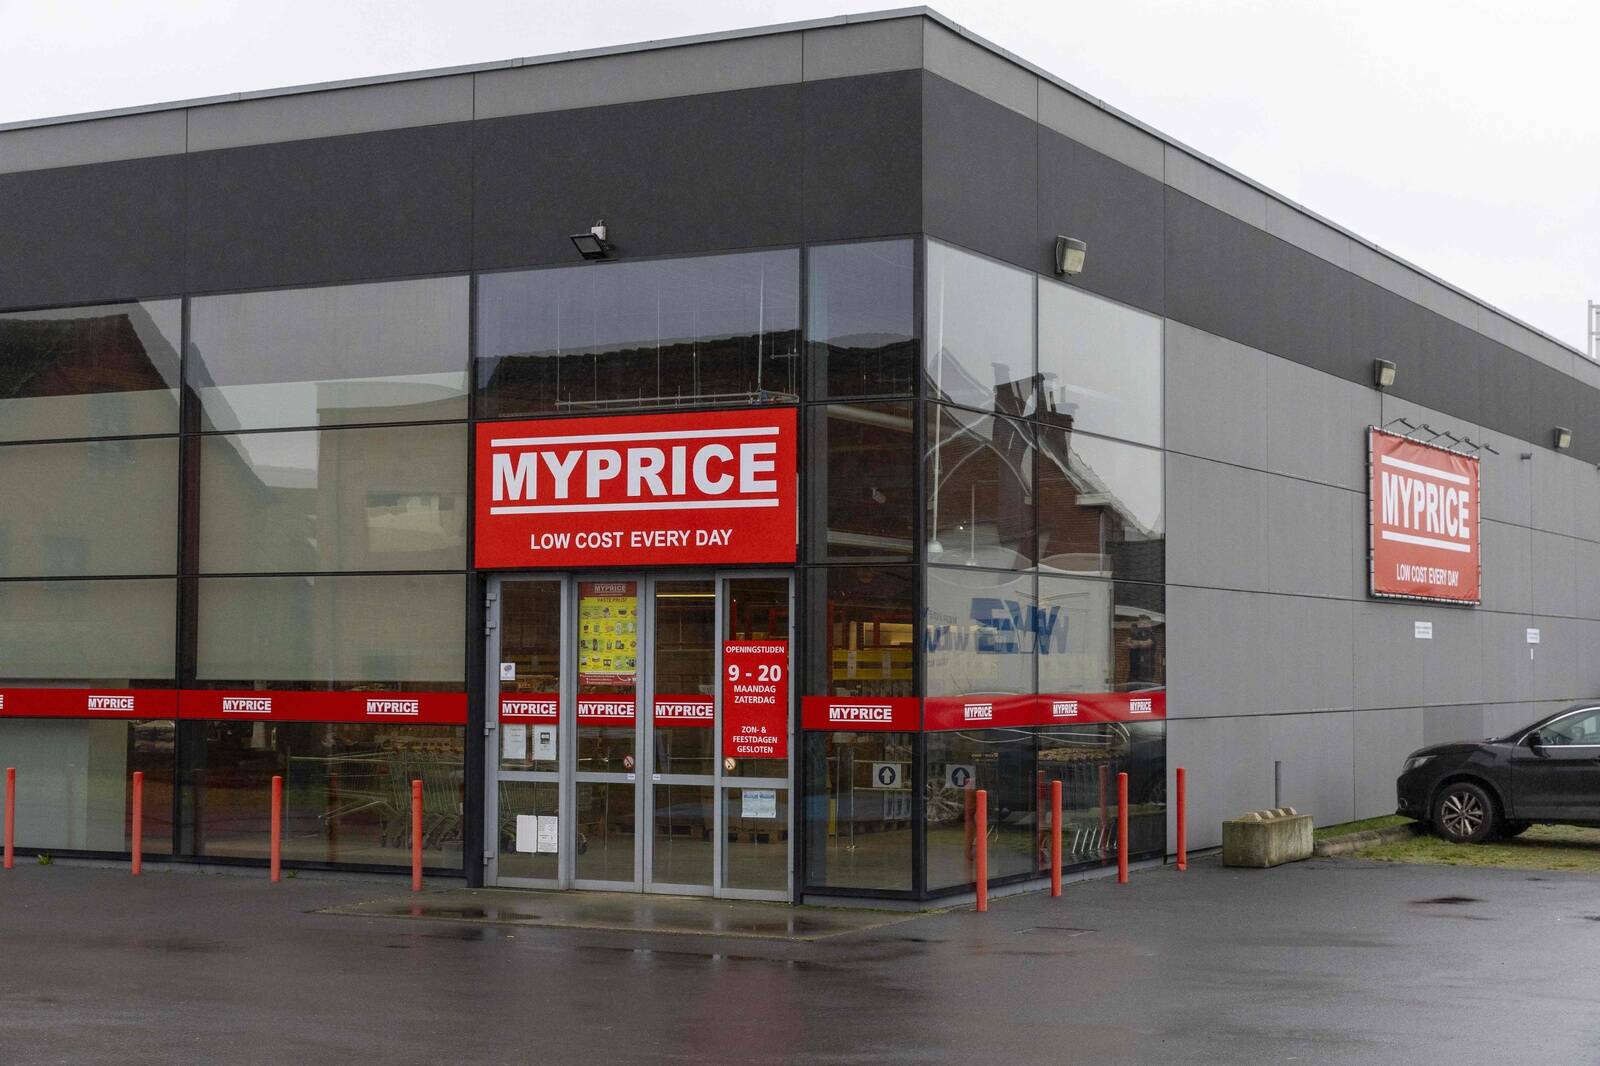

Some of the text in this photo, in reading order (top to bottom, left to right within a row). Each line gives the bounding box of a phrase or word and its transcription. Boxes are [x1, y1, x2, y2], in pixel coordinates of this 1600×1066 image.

[492, 442, 777, 501] MYPRICE
[1382, 472, 1470, 539] MYPRICE
[530, 529, 733, 550] LOW COST EVERY DAY
[1396, 564, 1459, 587] LOW COST EVERY DAY
[726, 646, 785, 654] OPENINGSTIJDEN
[728, 664, 740, 682] 9
[758, 664, 782, 682] 20
[734, 684, 776, 693] MAANDAG
[88, 698, 134, 709] MYPRICE
[223, 699, 271, 711] MYPRICE
[734, 696, 776, 704] ZATERDAG
[1130, 700, 1152, 712] MYPRICE
[367, 702, 418, 714] MYPRICE
[502, 703, 557, 714] MYPRICE
[579, 704, 635, 716] MYPRICE
[655, 705, 714, 718] MYPRICE
[830, 708, 892, 720] MYPRICE
[964, 706, 992, 718] MYPRICE
[1053, 703, 1078, 715] MYPRICE
[732, 736, 778, 744] FEESTDAGEN
[737, 746, 774, 754] GESLOTEN
